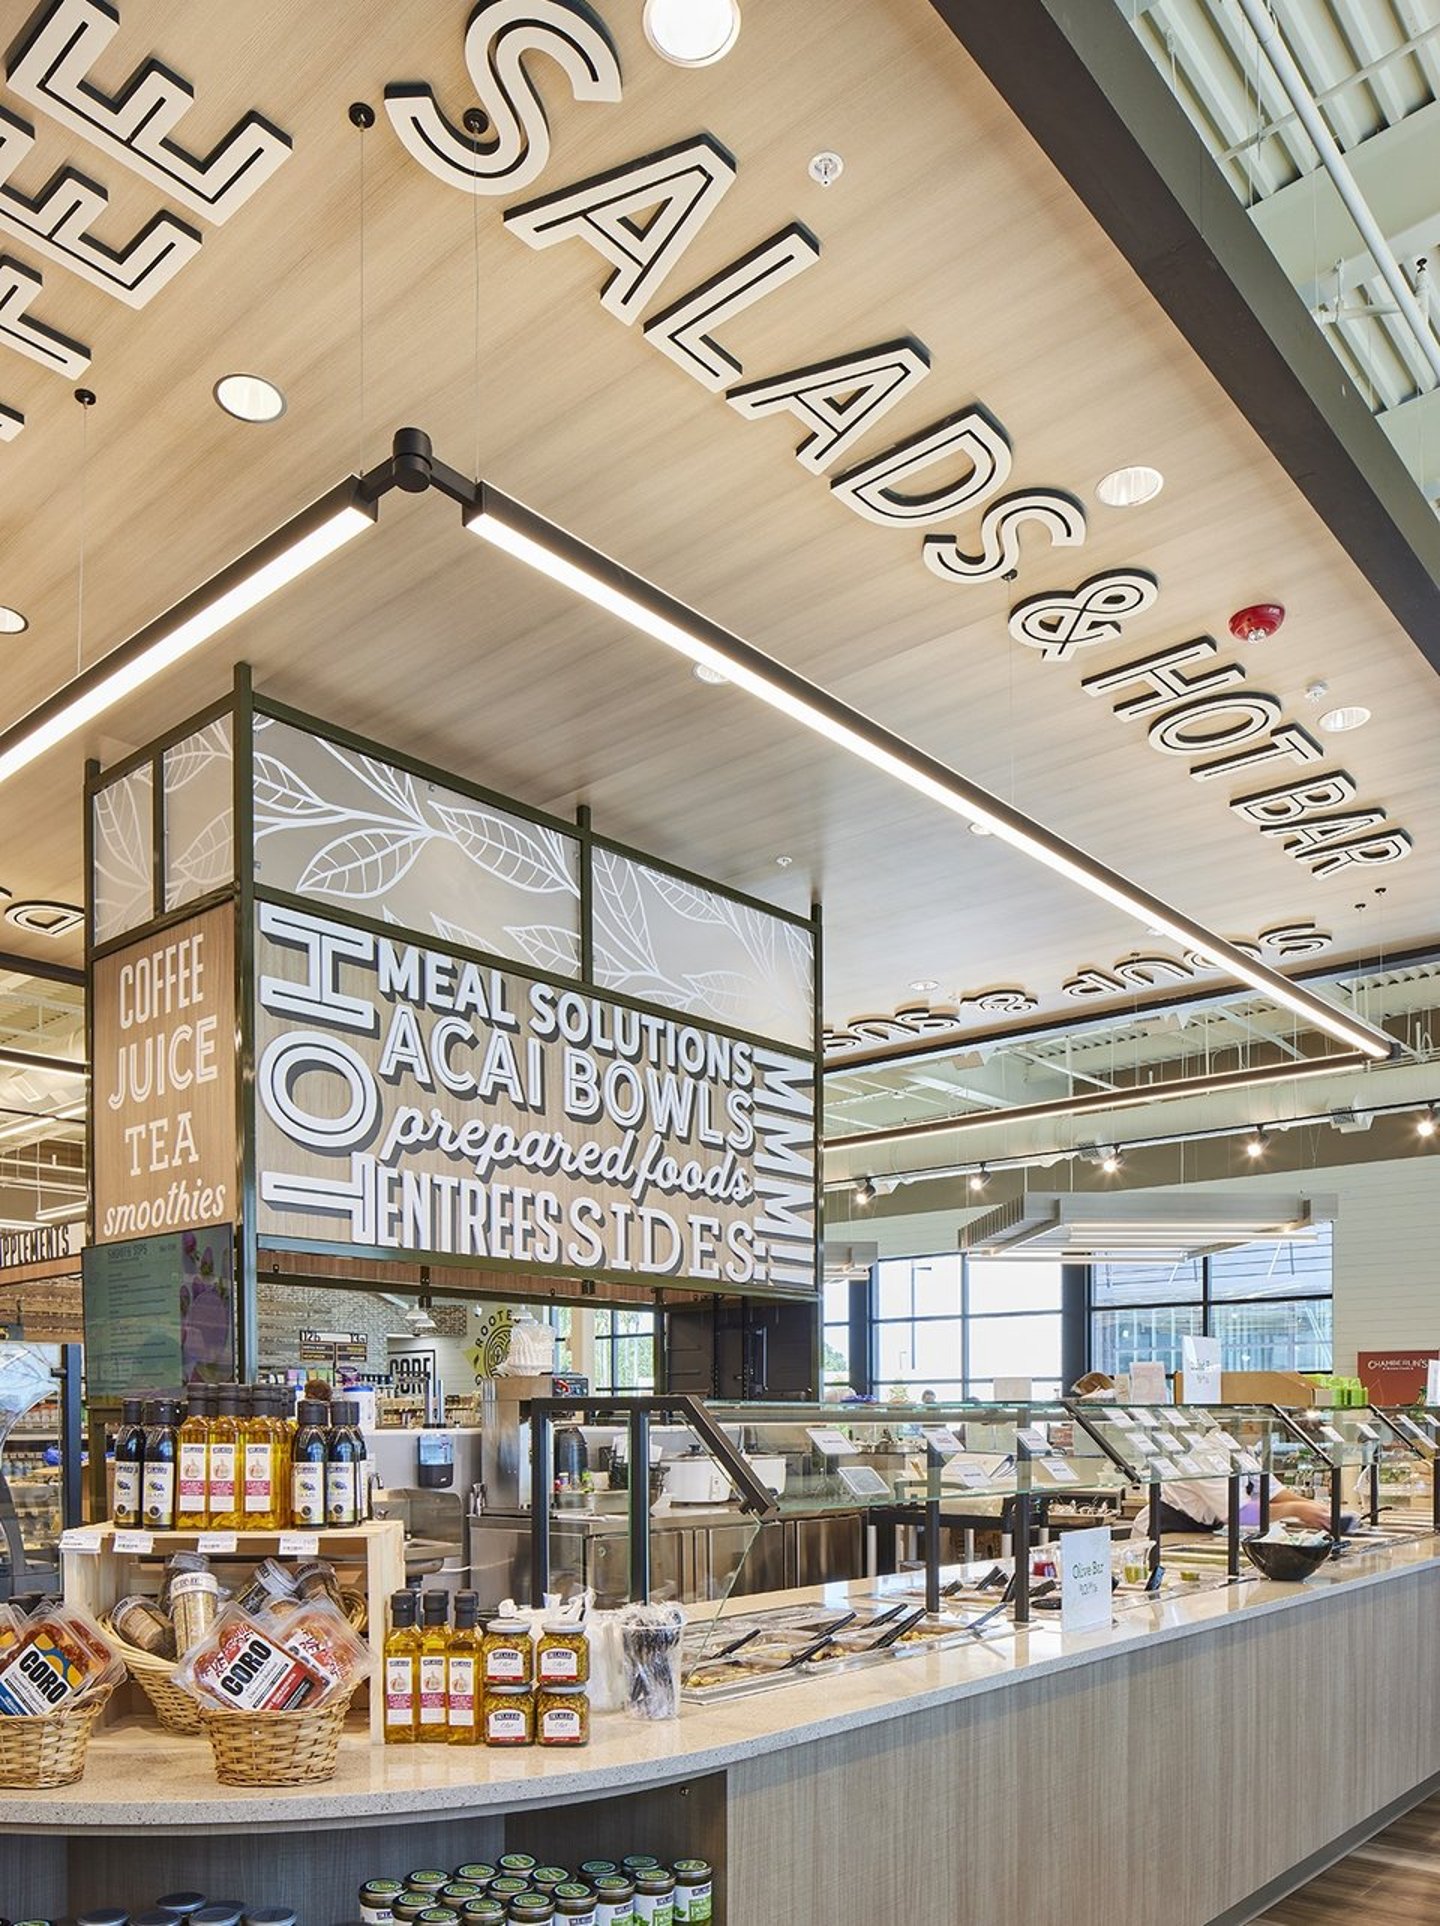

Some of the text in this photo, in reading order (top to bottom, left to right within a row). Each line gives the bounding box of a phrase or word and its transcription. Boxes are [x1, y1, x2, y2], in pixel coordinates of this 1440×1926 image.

[383, 0, 1414, 881] SALADS & HOT BAR
[119, 933, 204, 1031] COFFEE
[378, 941, 754, 1088] MEAL SOLUTIONS
[108, 1014, 219, 1111] JUICE
[260, 901, 382, 1247] HOT
[564, 1046, 755, 1151] BOWLS
[124, 1111, 199, 1177] TEA
[380, 1105, 756, 1202] prepared foods
[103, 1179, 226, 1237] smoothies
[381, 1167, 755, 1284] ENTREES SIDES
[19, 1650, 69, 1705] CORO
[220, 1638, 273, 1697] CORO
